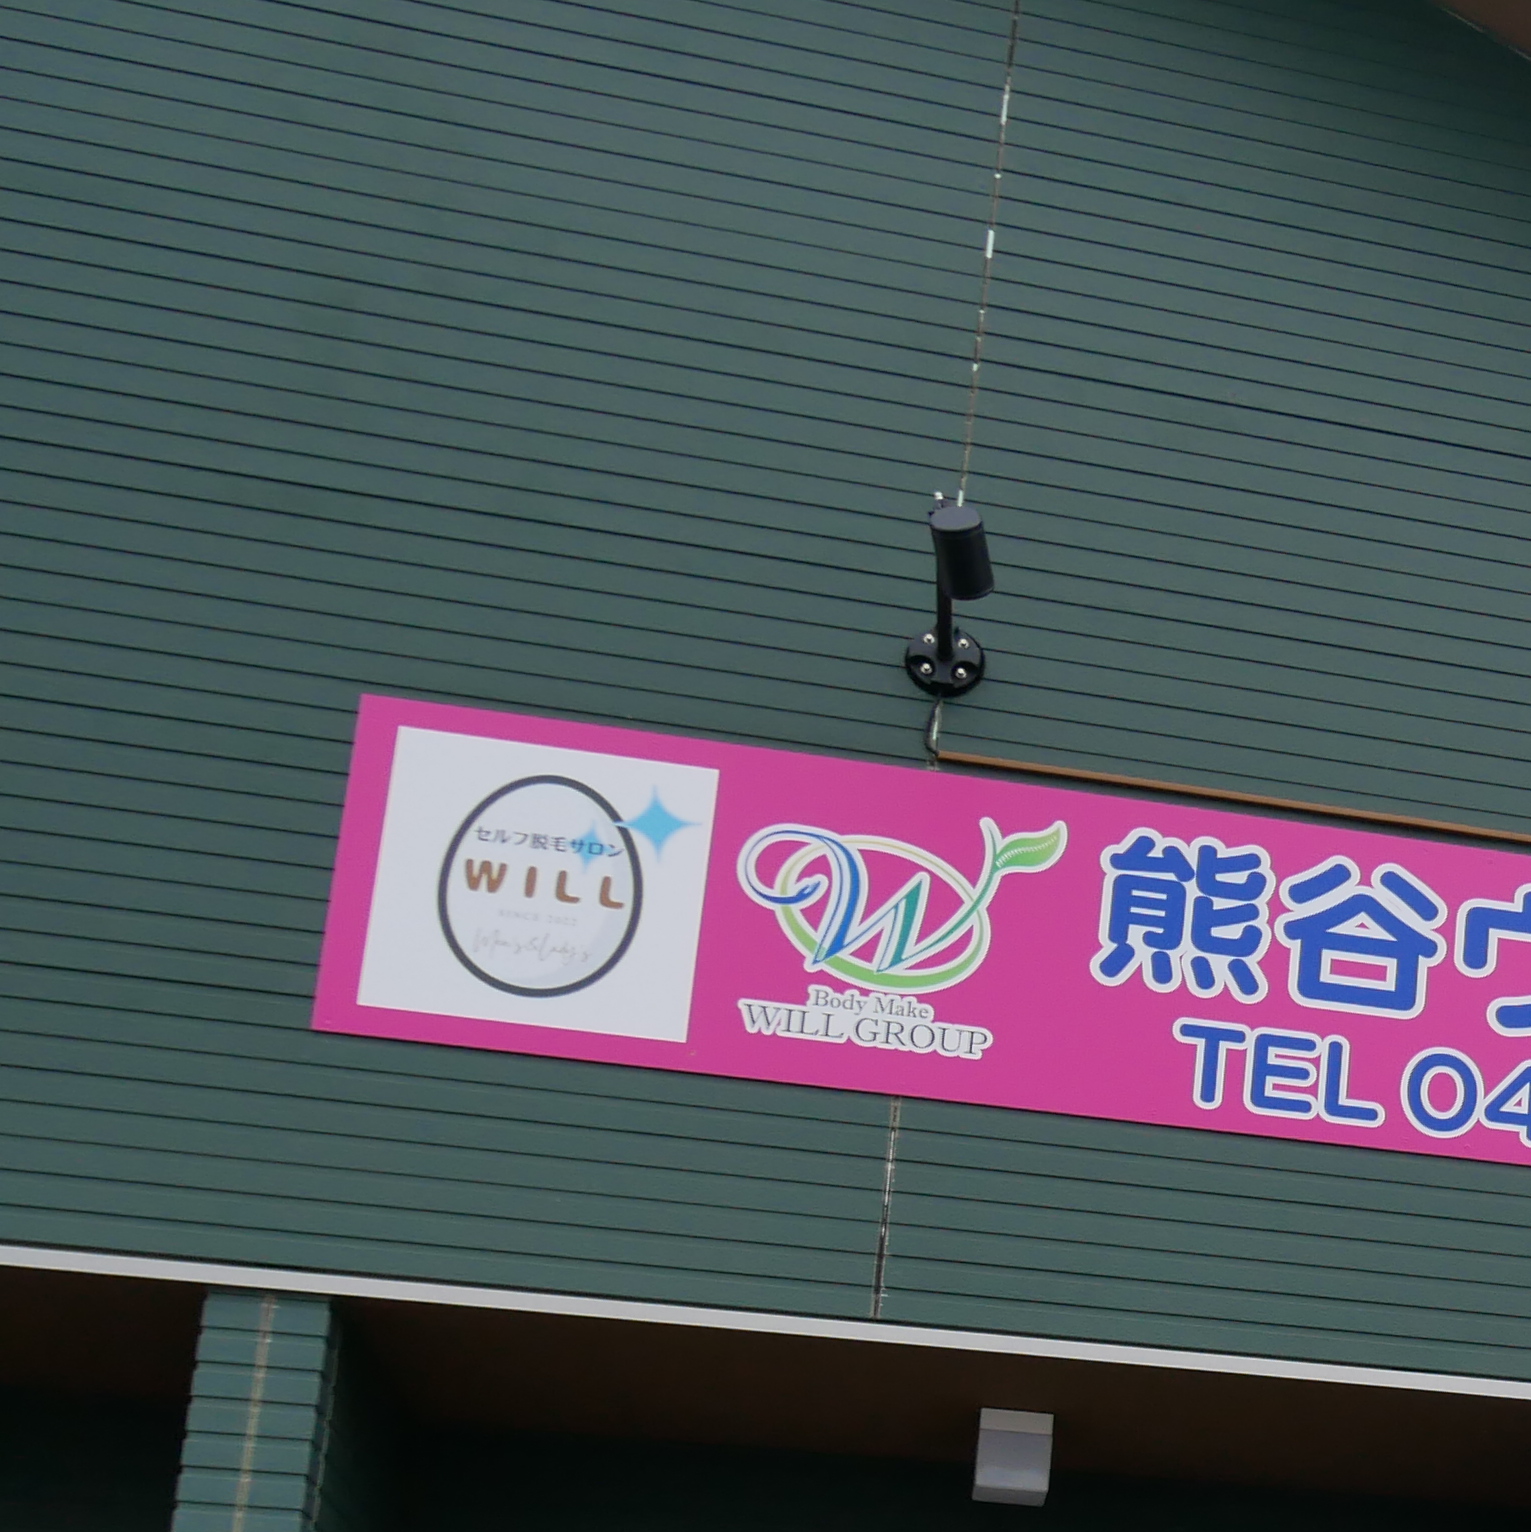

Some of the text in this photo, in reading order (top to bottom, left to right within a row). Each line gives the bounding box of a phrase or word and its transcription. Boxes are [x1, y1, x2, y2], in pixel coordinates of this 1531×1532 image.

[475, 826, 624, 857] セルフ脱毛サロン
[465, 859, 624, 909] WILL
[744, 1003, 988, 1055] WILL GROUP
[813, 989, 929, 1019] Body Make
[1180, 1023, 1379, 1122] TEL
